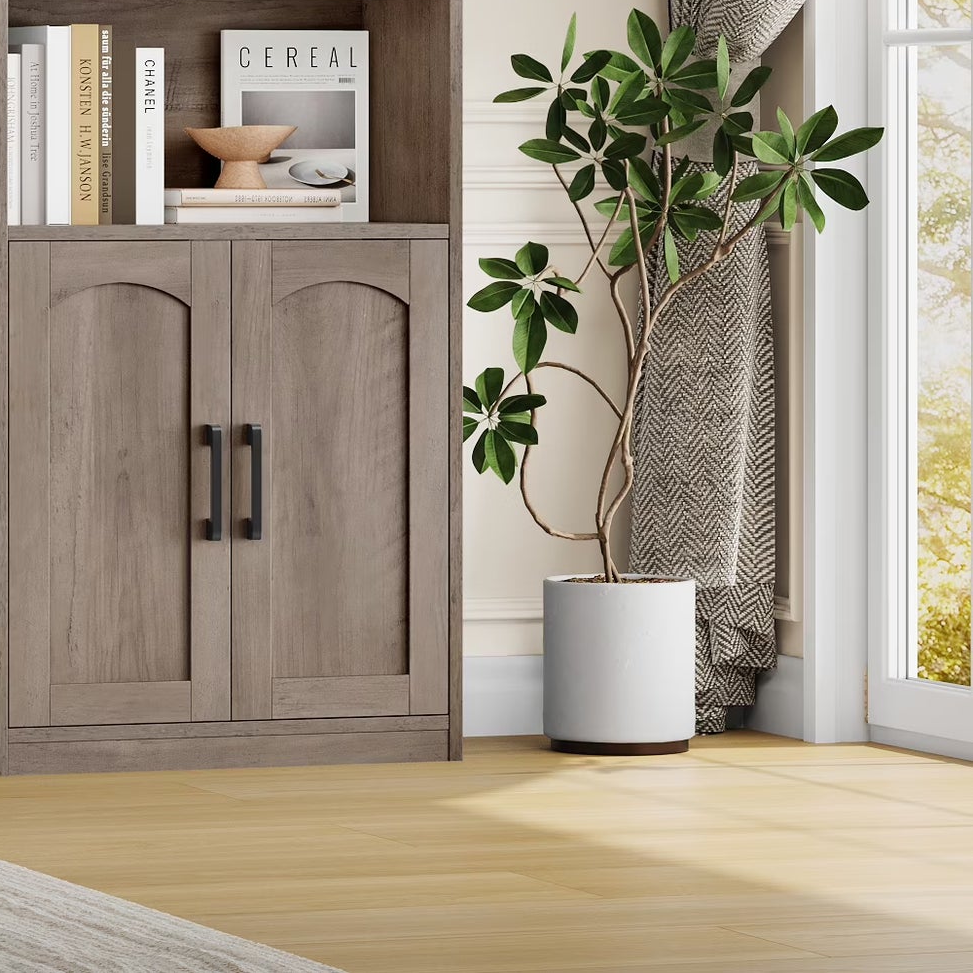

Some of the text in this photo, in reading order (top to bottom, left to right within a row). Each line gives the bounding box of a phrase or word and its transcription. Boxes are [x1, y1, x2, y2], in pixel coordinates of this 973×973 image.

[144, 59, 156, 114] CHANEL
[239, 47, 357, 68] CEREAL
[27, 61, 40, 162] At Home in Joshua Tree
[79, 58, 92, 116] KONSTEN
[101, 29, 112, 213] saum für alla die sünderin lise Grandsun
